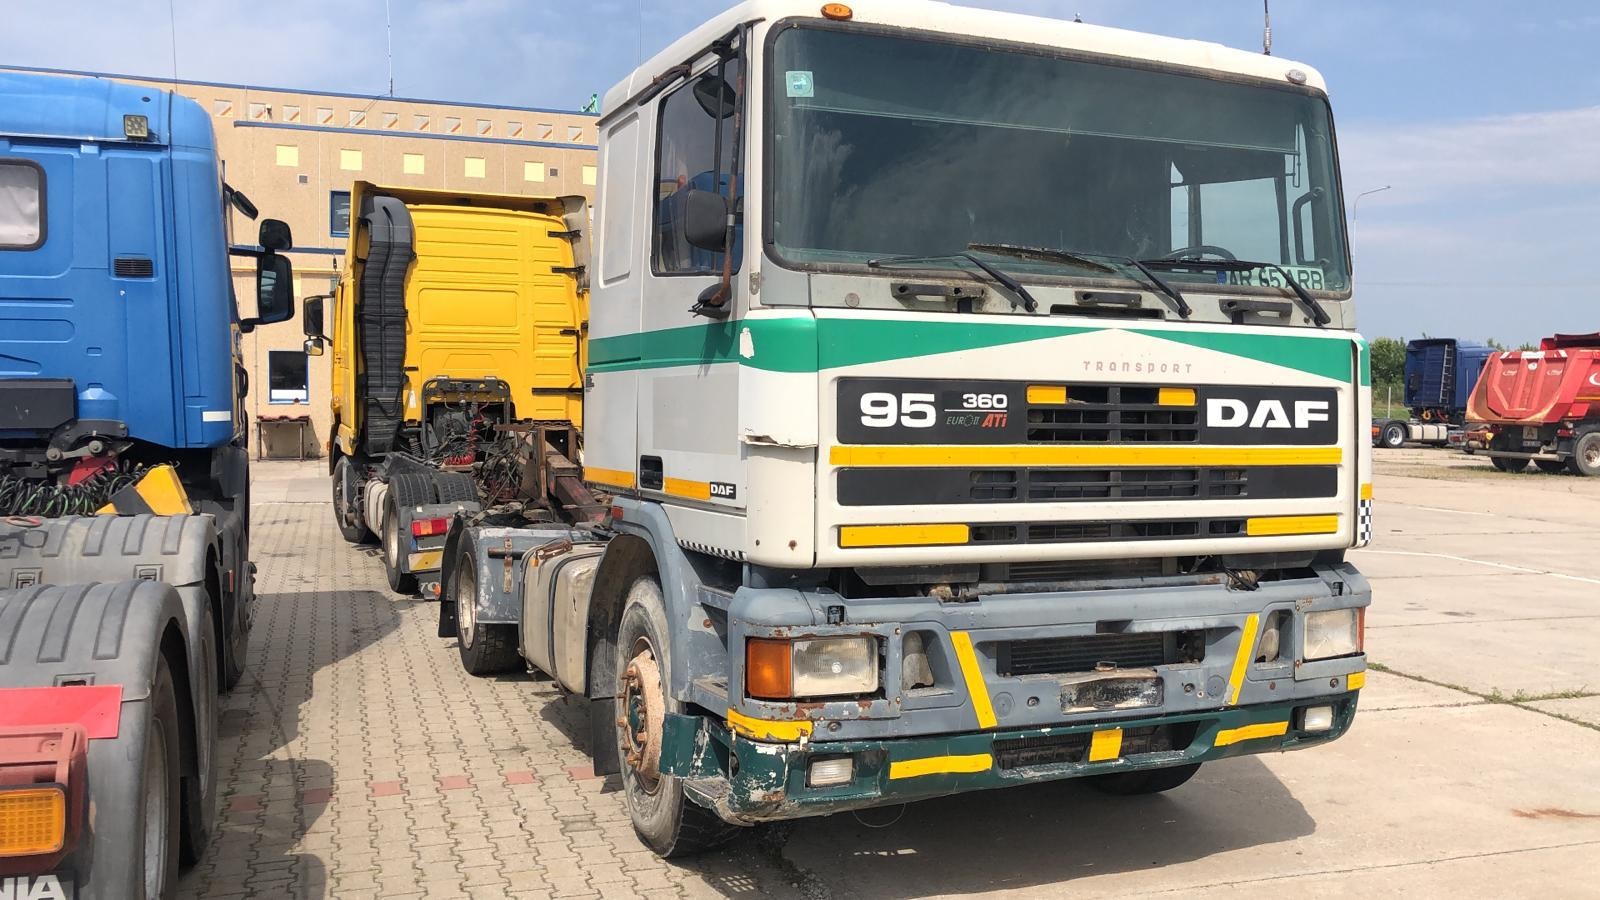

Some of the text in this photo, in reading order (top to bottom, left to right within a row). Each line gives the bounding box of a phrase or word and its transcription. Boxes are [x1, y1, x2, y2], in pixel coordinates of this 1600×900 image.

[1083, 361, 1192, 374] TRANSPORT
[962, 393, 1008, 409] 360
[860, 392, 936, 428] 95
[1206, 398, 1329, 428] DAF
[710, 483, 734, 496] DAF
